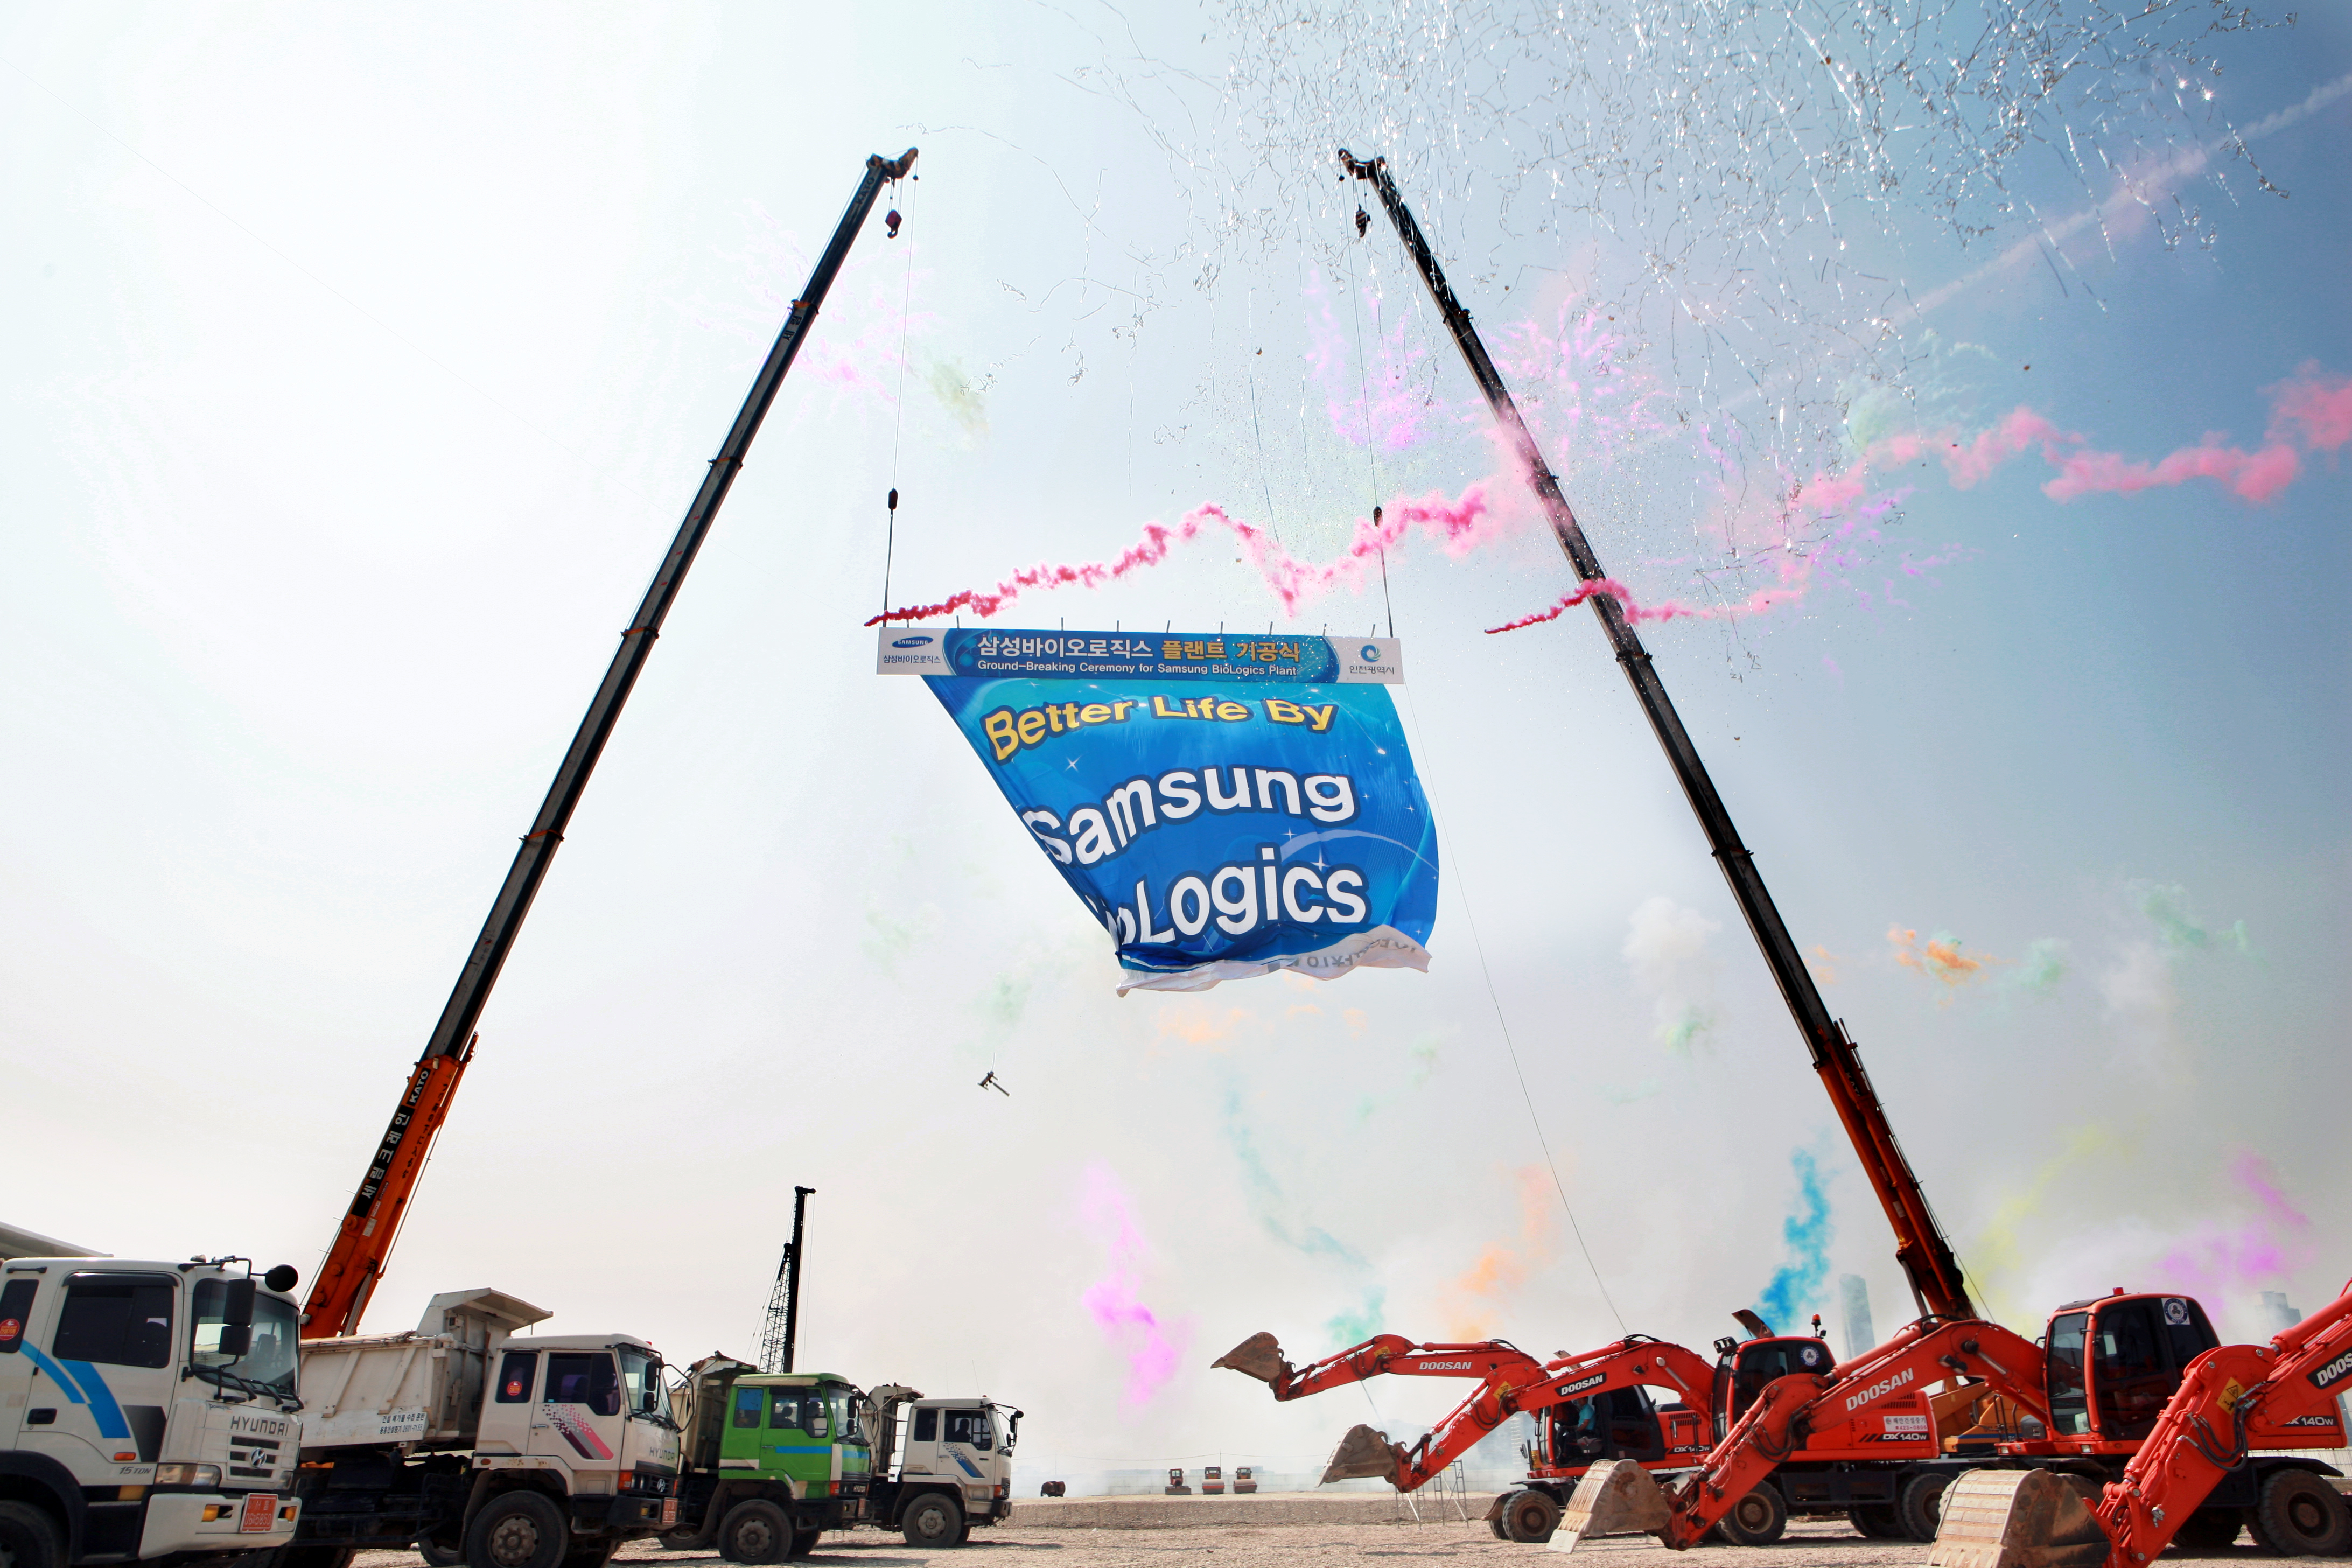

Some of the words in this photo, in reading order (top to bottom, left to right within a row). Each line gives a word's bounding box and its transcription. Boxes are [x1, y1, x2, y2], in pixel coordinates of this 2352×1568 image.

[883, 655, 941, 664] 삼성바이오로직스
[977, 636, 1153, 659] 삼성바이오로직스
[1161, 640, 1228, 660] 플랜트
[1236, 641, 1300, 662] 기공식
[978, 660, 1076, 673] Ground-Breaking
[1080, 662, 1136, 674] Ceremony
[1139, 663, 1154, 673] for
[1158, 663, 1208, 675] Samsung
[1212, 664, 1265, 675] BioLogics
[1269, 665, 1297, 676] Plant
[1349, 666, 1395, 675] 인천광역시
[985, 699, 1133, 760] Better
[1154, 697, 1248, 722] Life
[1266, 699, 1337, 731] By
[1022, 767, 1355, 865] Samsung
[409, 1070, 429, 1104] KATO
[361, 1112, 411, 1199] 세림크레인
[1419, 1361, 1472, 1370] DOOSAN
[1561, 1374, 1604, 1396] DOOSAN
[1846, 1367, 1914, 1411] DOOSAN
[230, 1415, 289, 1437] HYUNDAI
